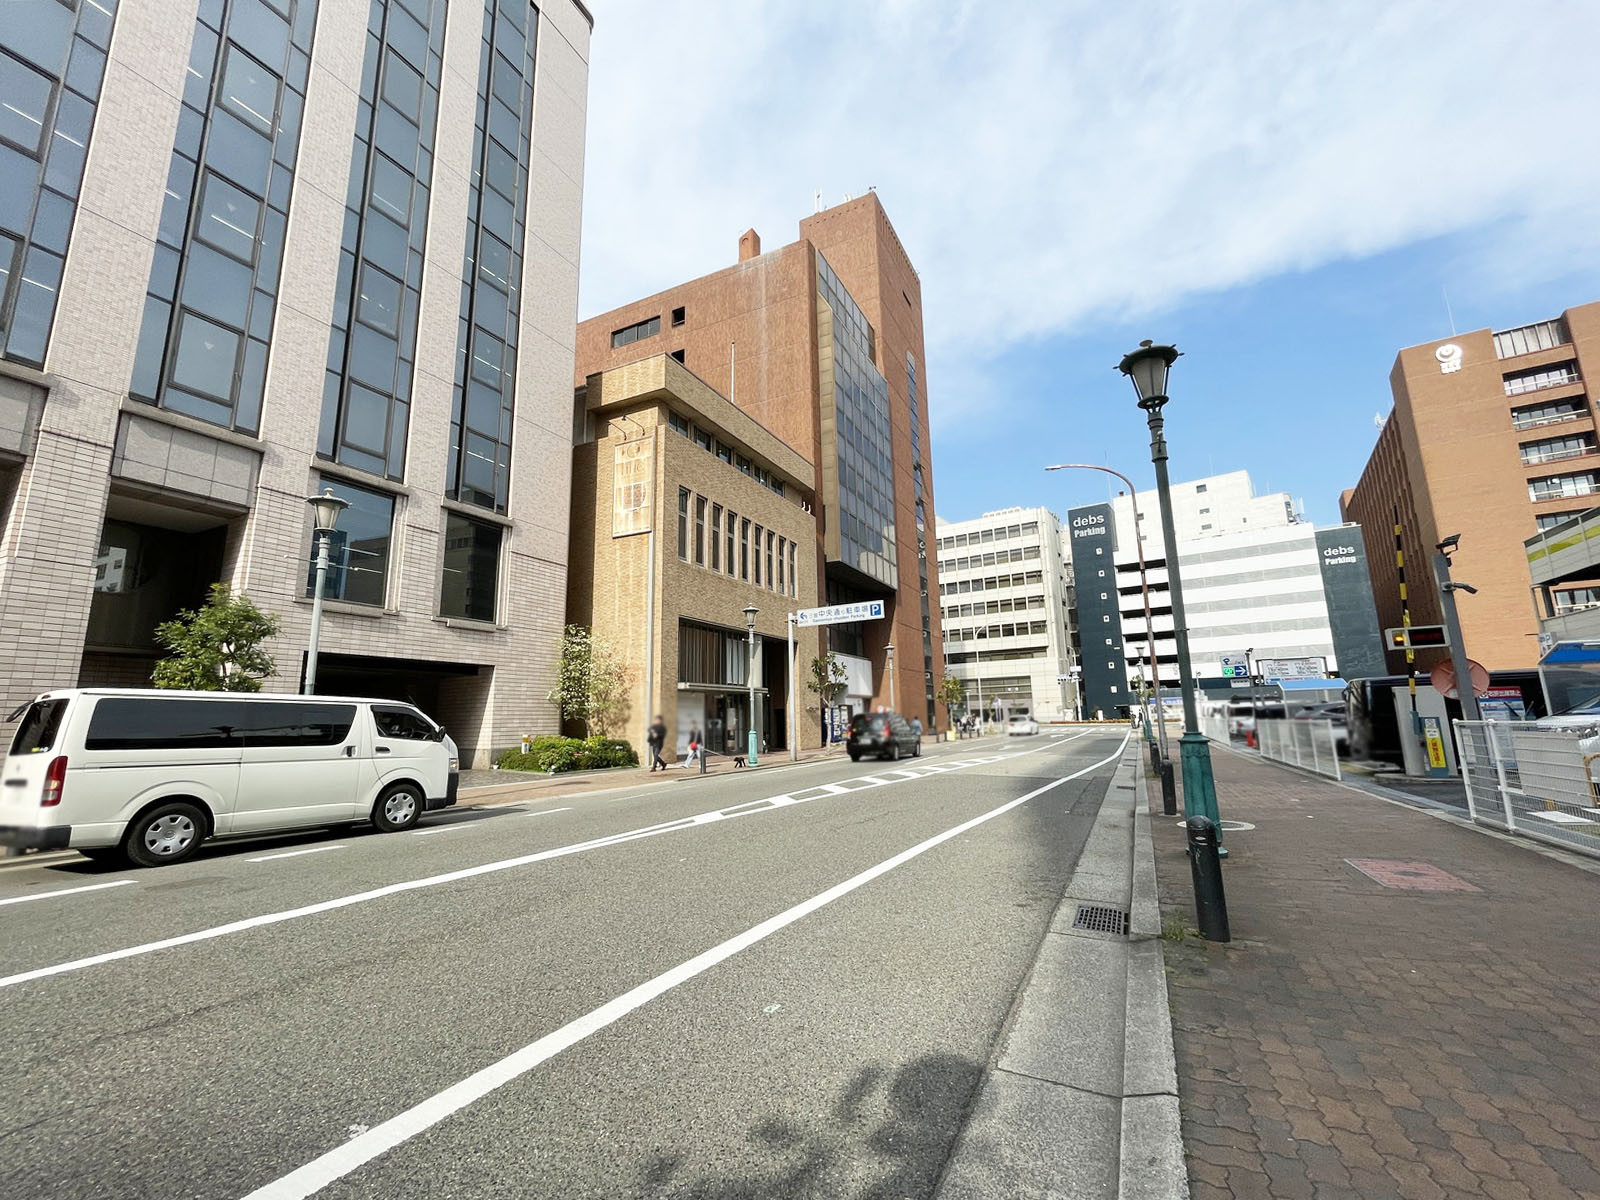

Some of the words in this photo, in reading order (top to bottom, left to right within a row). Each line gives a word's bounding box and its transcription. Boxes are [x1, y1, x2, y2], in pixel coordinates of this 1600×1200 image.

[1073, 514, 1105, 527] debs
[1074, 526, 1106, 538] Parking
[1323, 546, 1355, 557] debs
[1325, 556, 1357, 566] Parking
[871, 604, 880, 616] P
